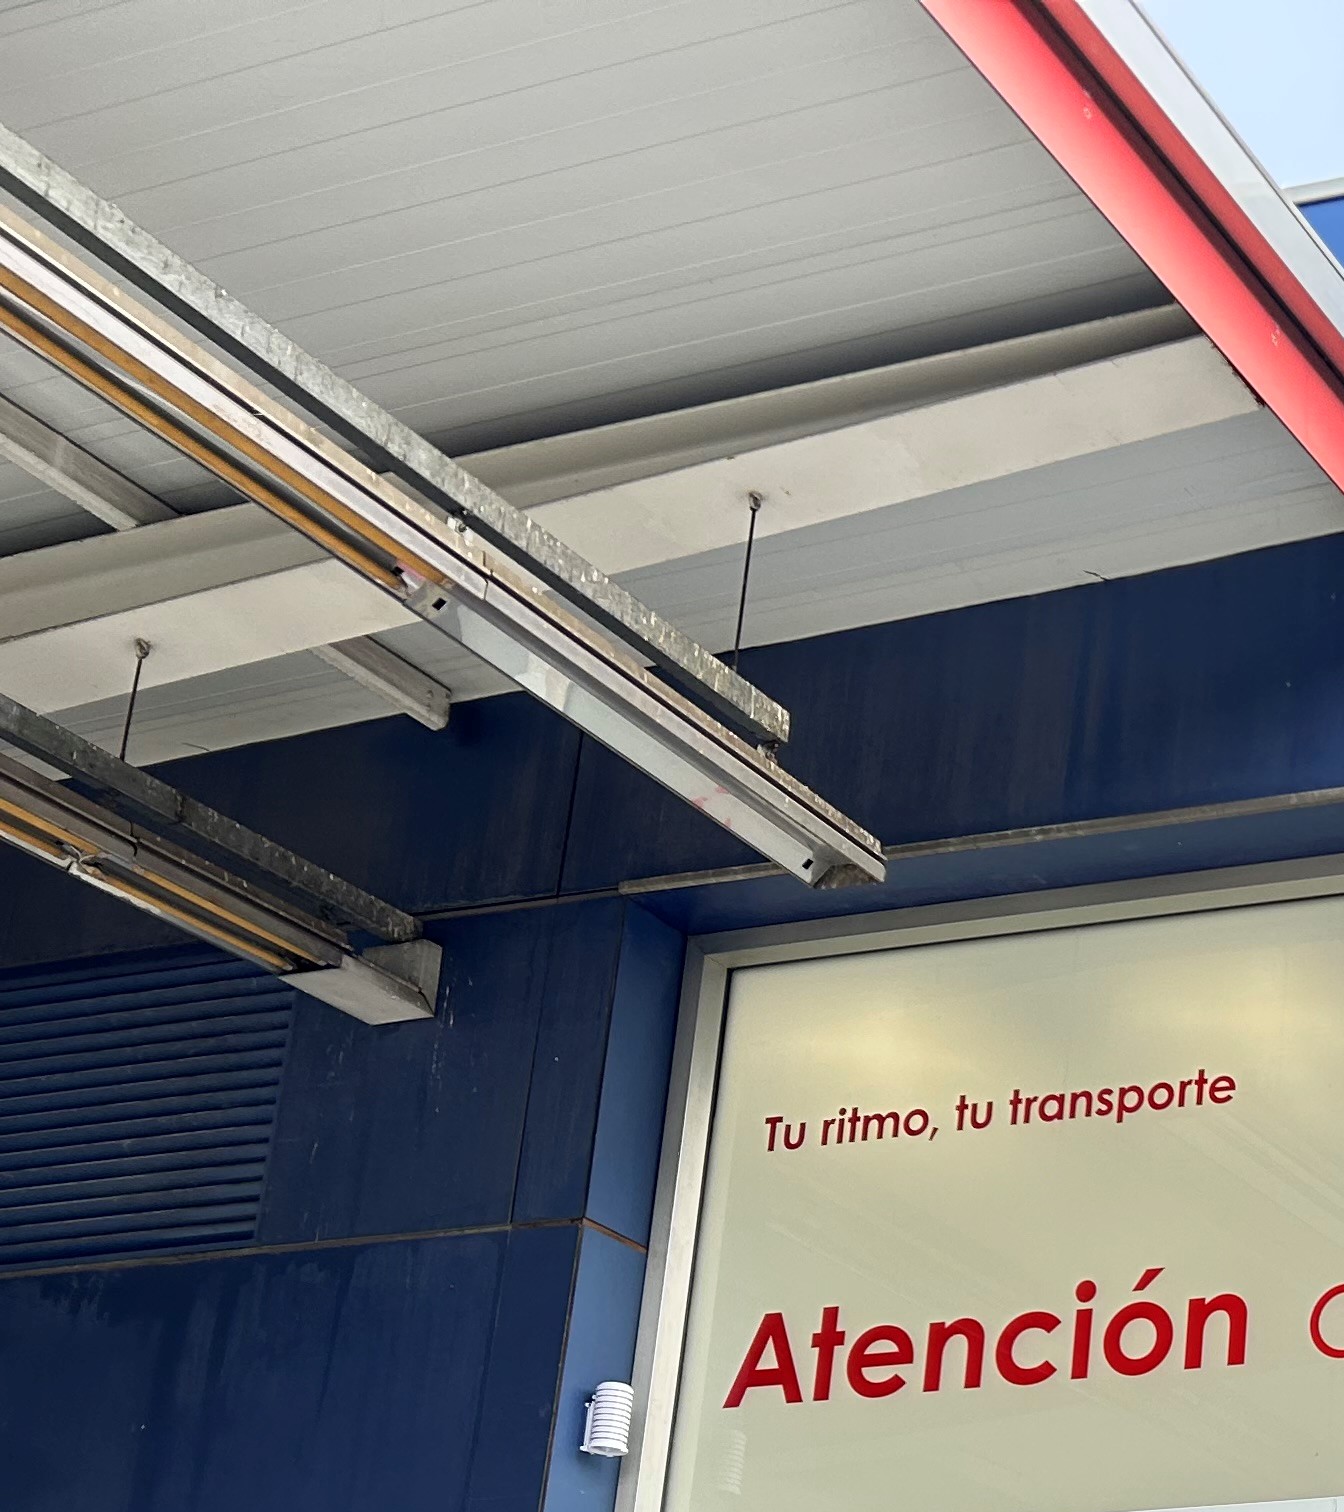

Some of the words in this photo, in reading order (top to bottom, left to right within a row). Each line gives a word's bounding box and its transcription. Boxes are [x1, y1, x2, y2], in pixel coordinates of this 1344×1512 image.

[765, 1116, 806, 1152] Tu
[820, 1106, 939, 1146] ritmo,
[955, 1094, 993, 1131] tu
[1009, 1068, 1236, 1125] transporte
[722, 1267, 1248, 1409] Atención
